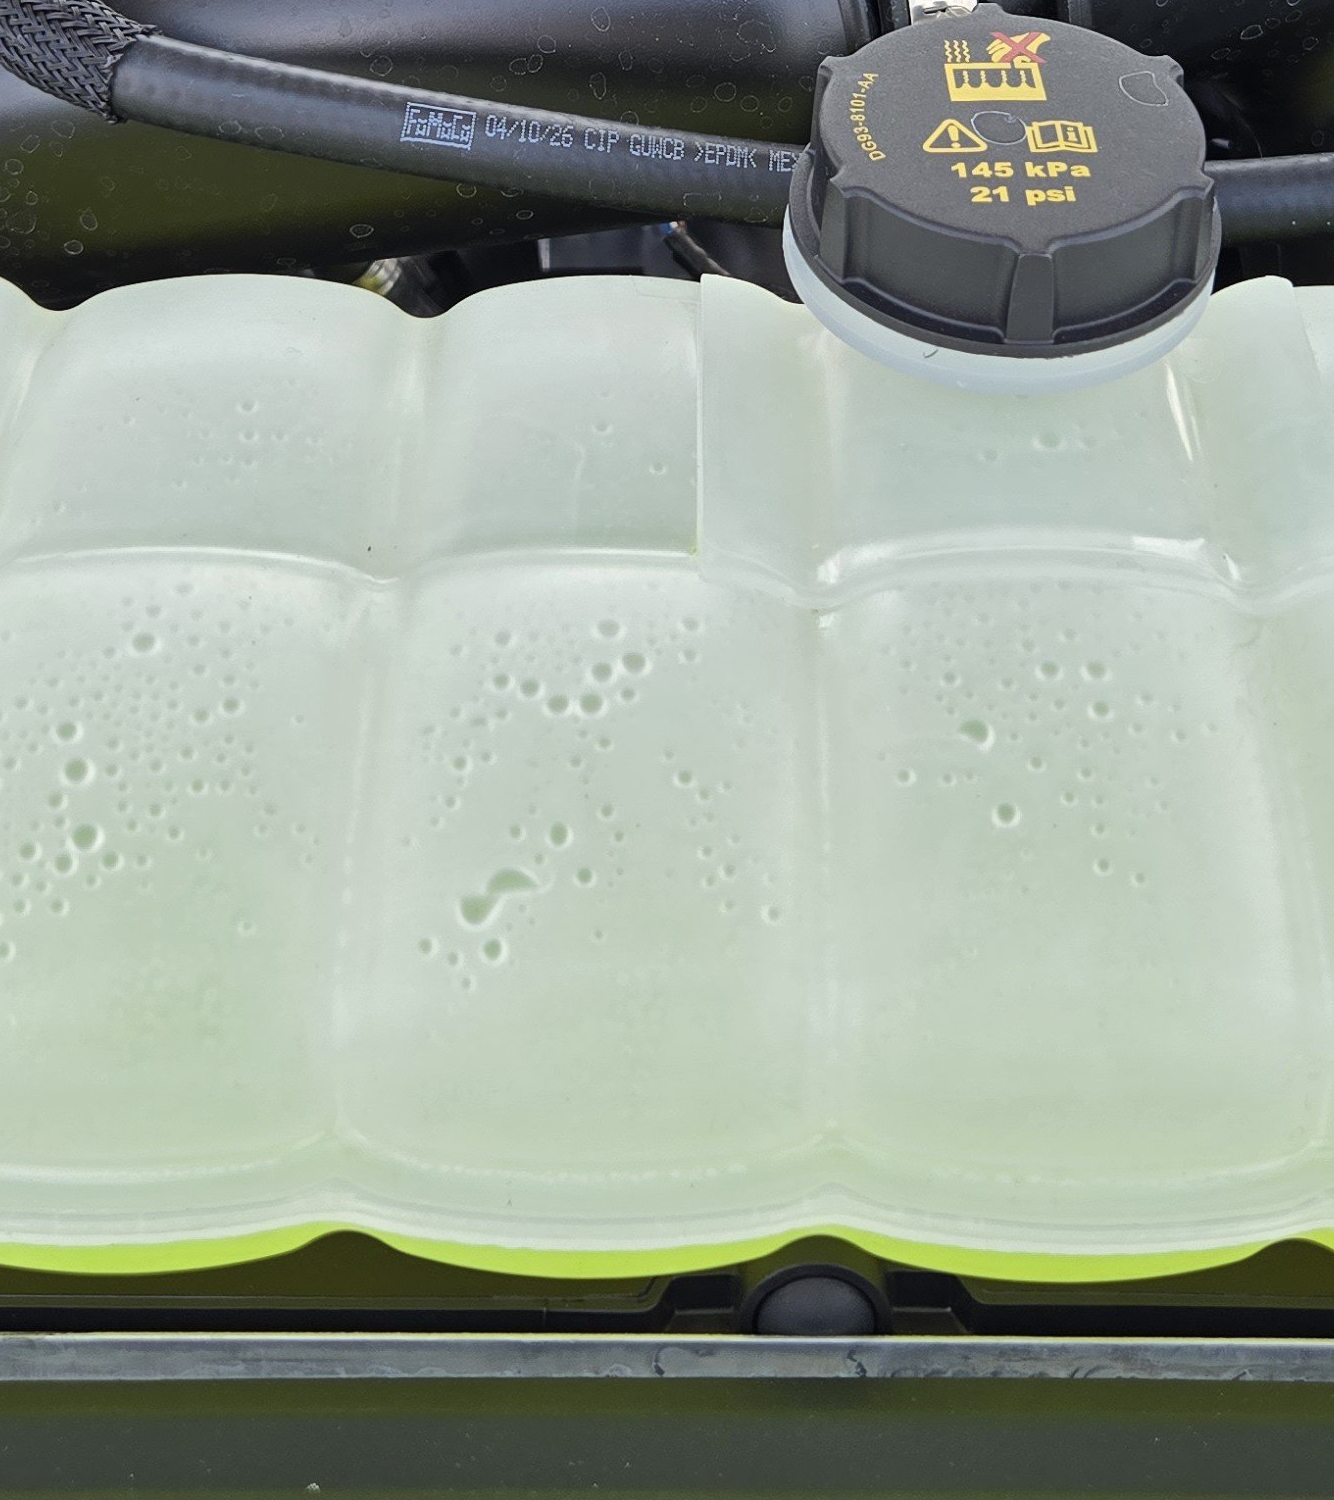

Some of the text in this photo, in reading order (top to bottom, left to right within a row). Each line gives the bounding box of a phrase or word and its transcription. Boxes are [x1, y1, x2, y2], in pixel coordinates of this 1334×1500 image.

[404, 106, 471, 144] FoMoCo
[485, 114, 574, 148] 04/10/26
[584, 128, 619, 153] CIP
[849, 72, 886, 162] DG93-8101-AA
[950, 161, 1092, 178] 145 kPa
[969, 186, 1077, 206] 21 psi
